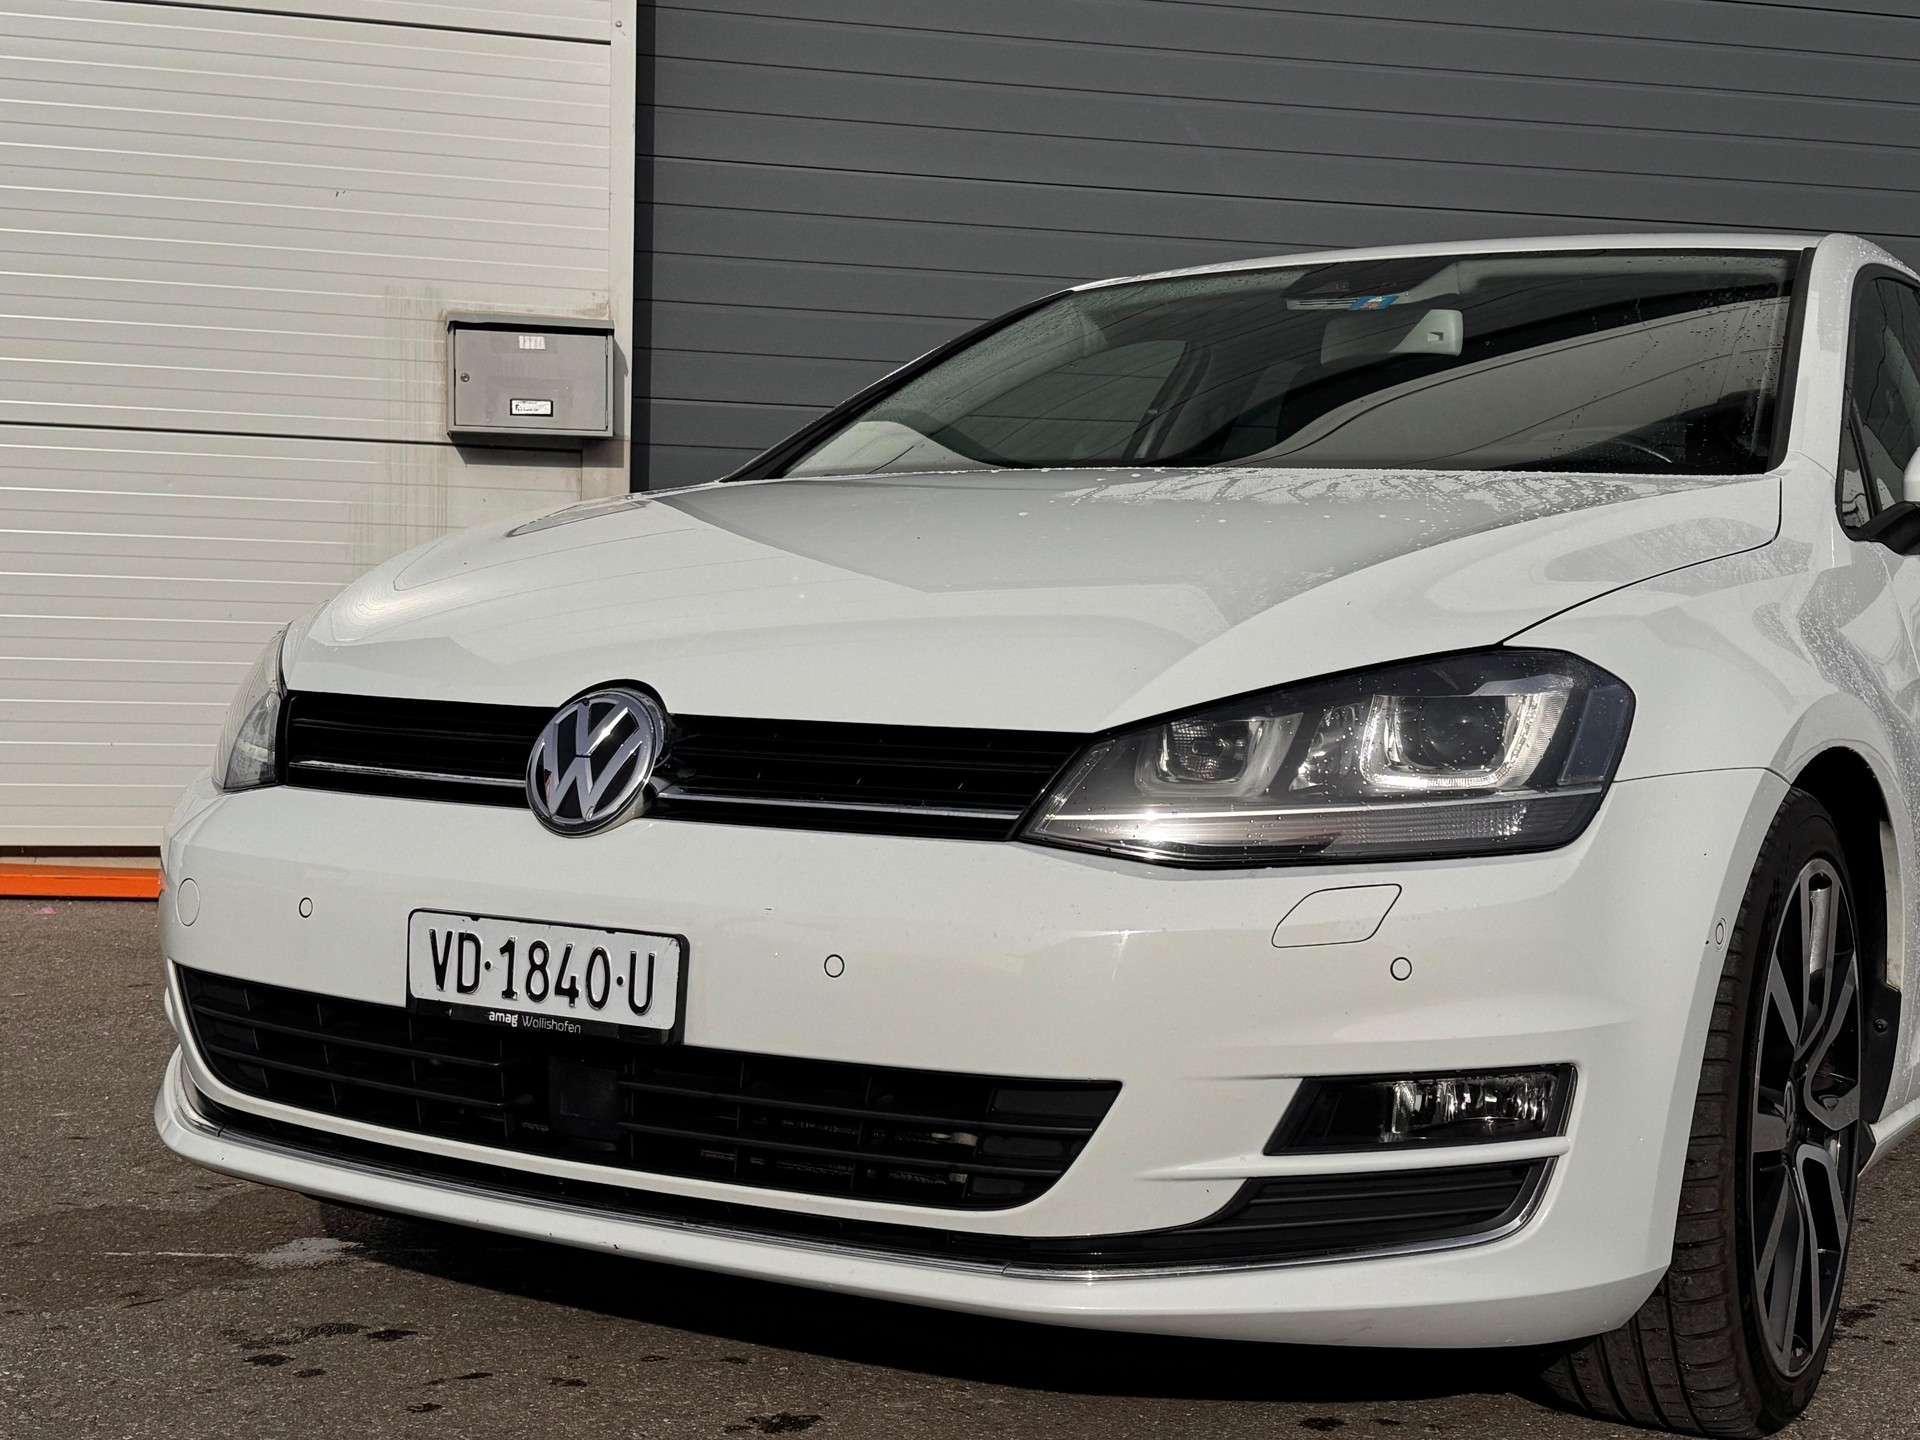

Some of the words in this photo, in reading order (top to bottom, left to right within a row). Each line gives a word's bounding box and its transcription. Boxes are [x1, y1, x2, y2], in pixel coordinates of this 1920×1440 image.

[534, 695, 647, 824] VW
[488, 1011, 518, 1028] amag
[521, 1014, 581, 1034] Wollishofen
